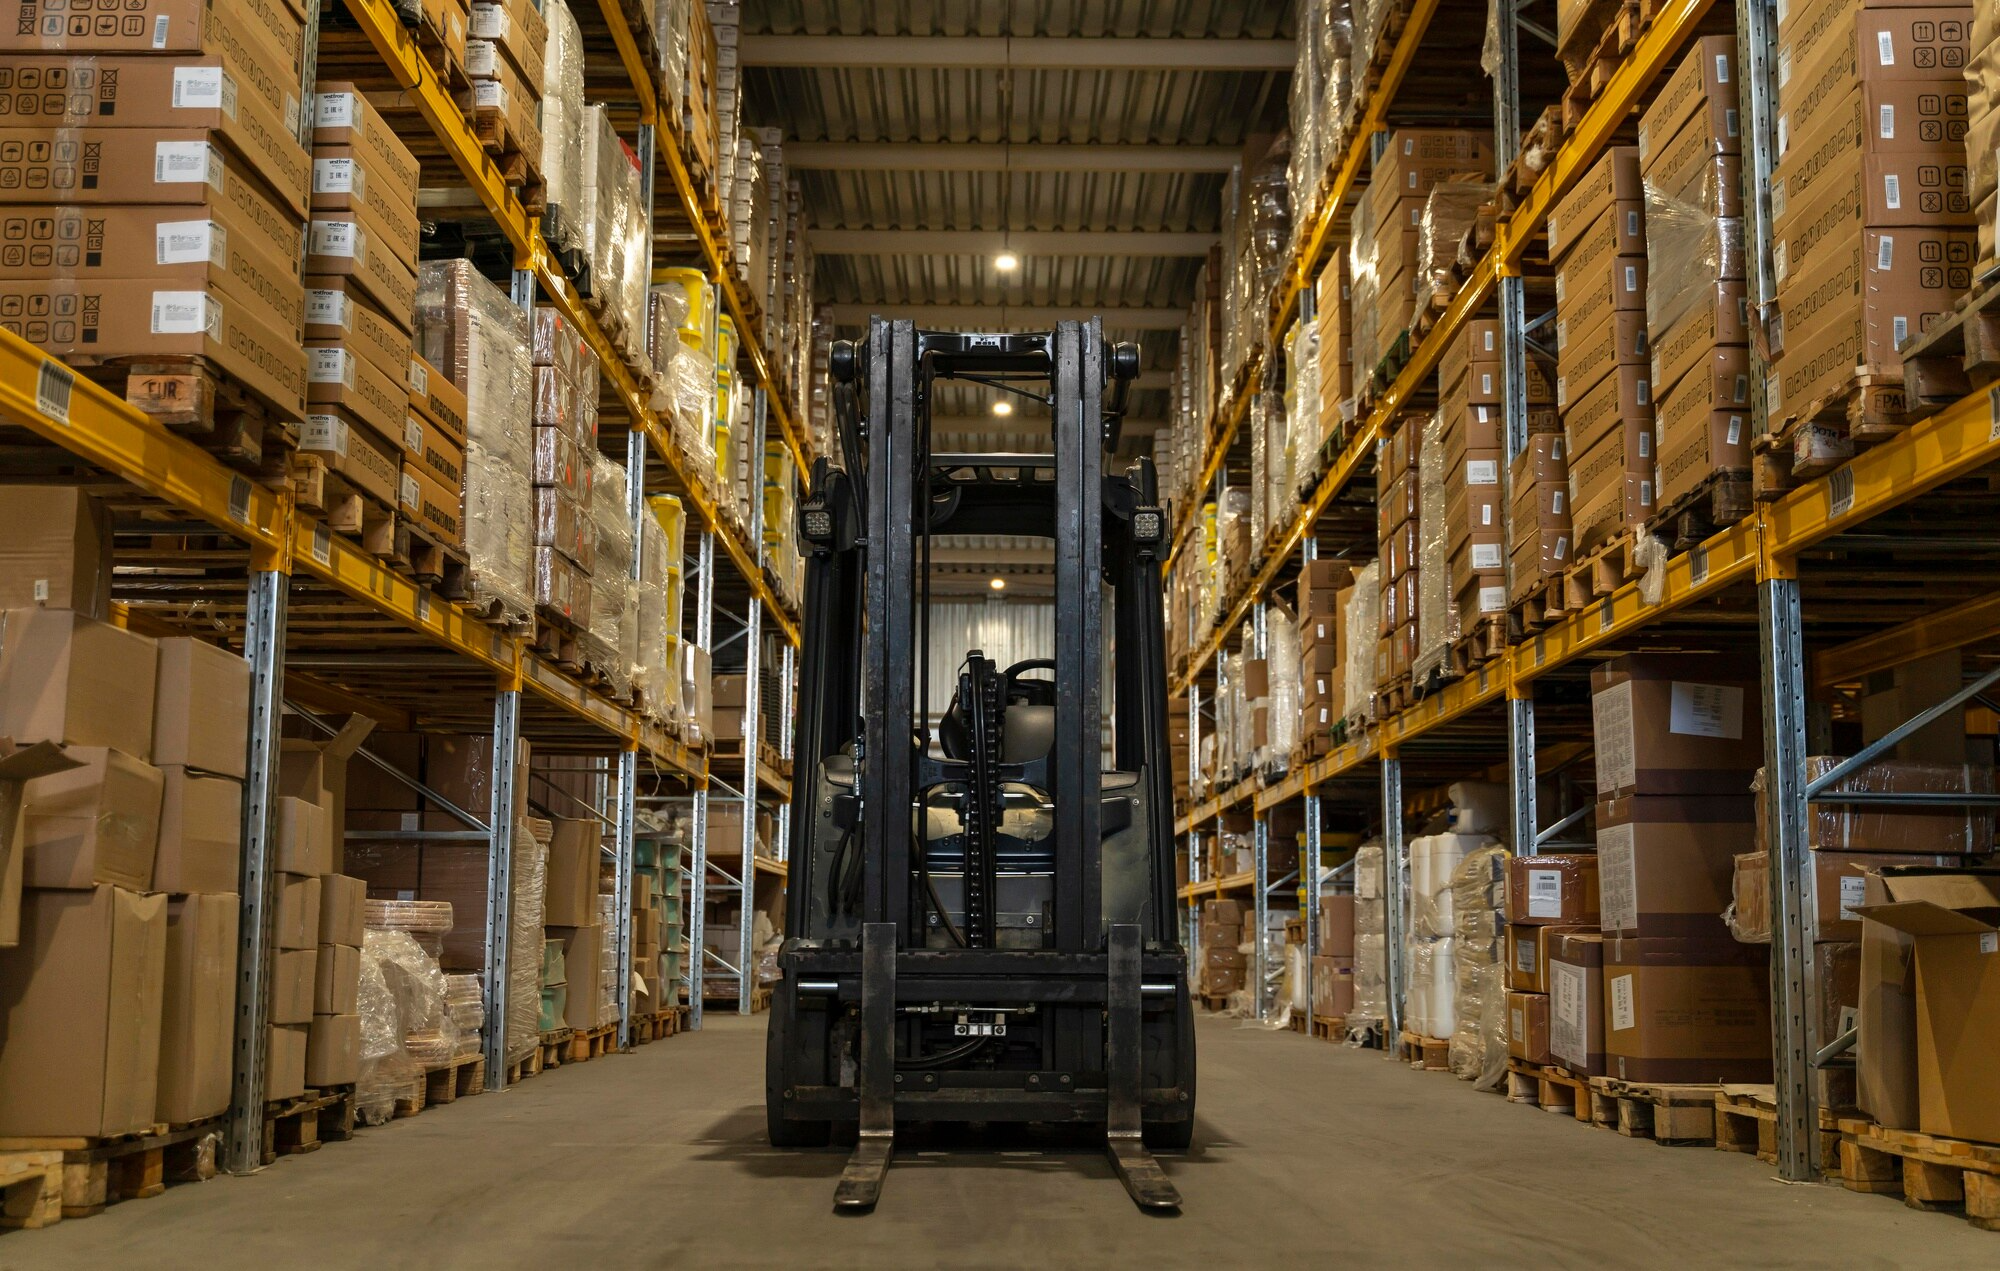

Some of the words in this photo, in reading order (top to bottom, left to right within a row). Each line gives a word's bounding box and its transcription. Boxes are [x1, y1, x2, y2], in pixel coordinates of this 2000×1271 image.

[102, 88, 114, 97] 15
[86, 161, 97, 170] 15
[90, 239, 101, 247] 15
[85, 315, 97, 323] 15
[148, 381, 177, 400] EUR
